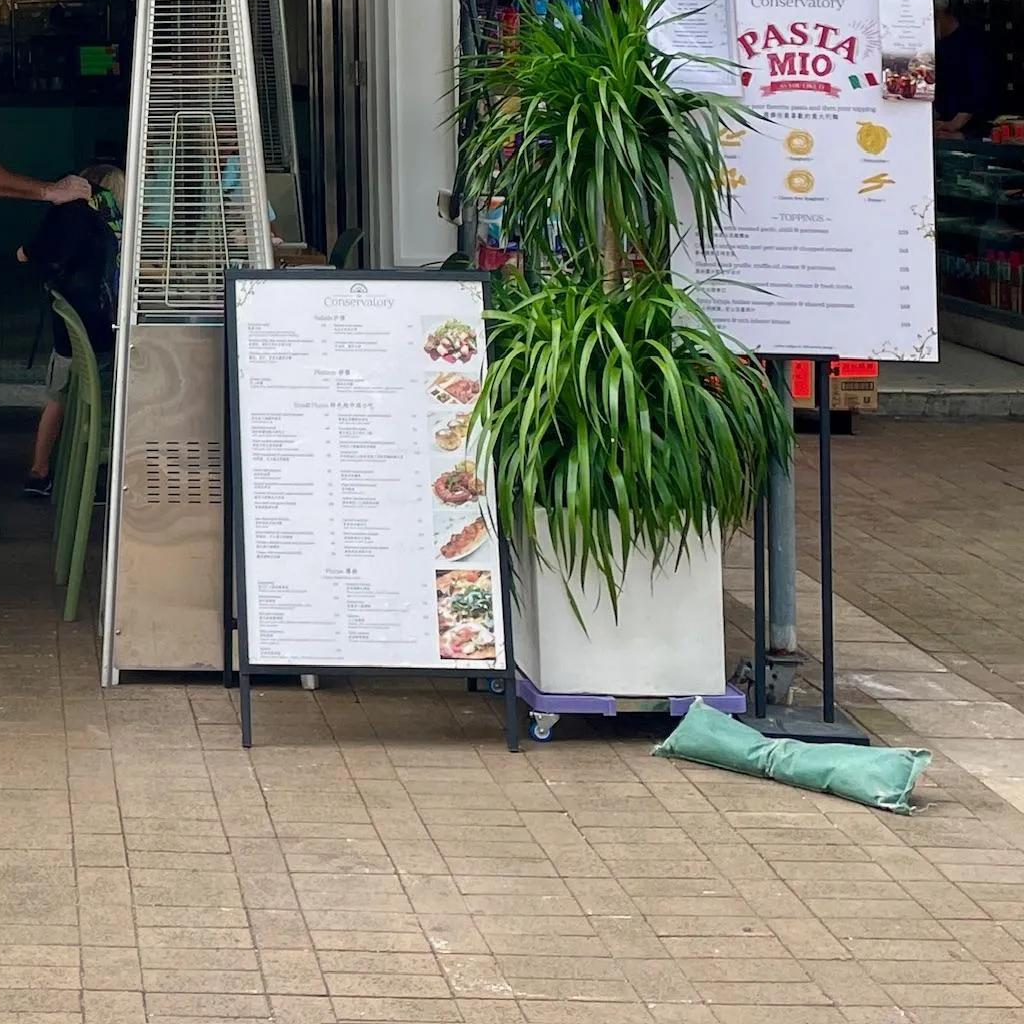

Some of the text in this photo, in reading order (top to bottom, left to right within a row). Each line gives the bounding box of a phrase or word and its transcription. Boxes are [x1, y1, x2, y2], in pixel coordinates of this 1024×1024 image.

[737, 21, 858, 65] PASTA
[766, 52, 832, 77] MIO
[779, 213, 824, 223] TOPPINGS
[323, 296, 394, 309] Conservatory
